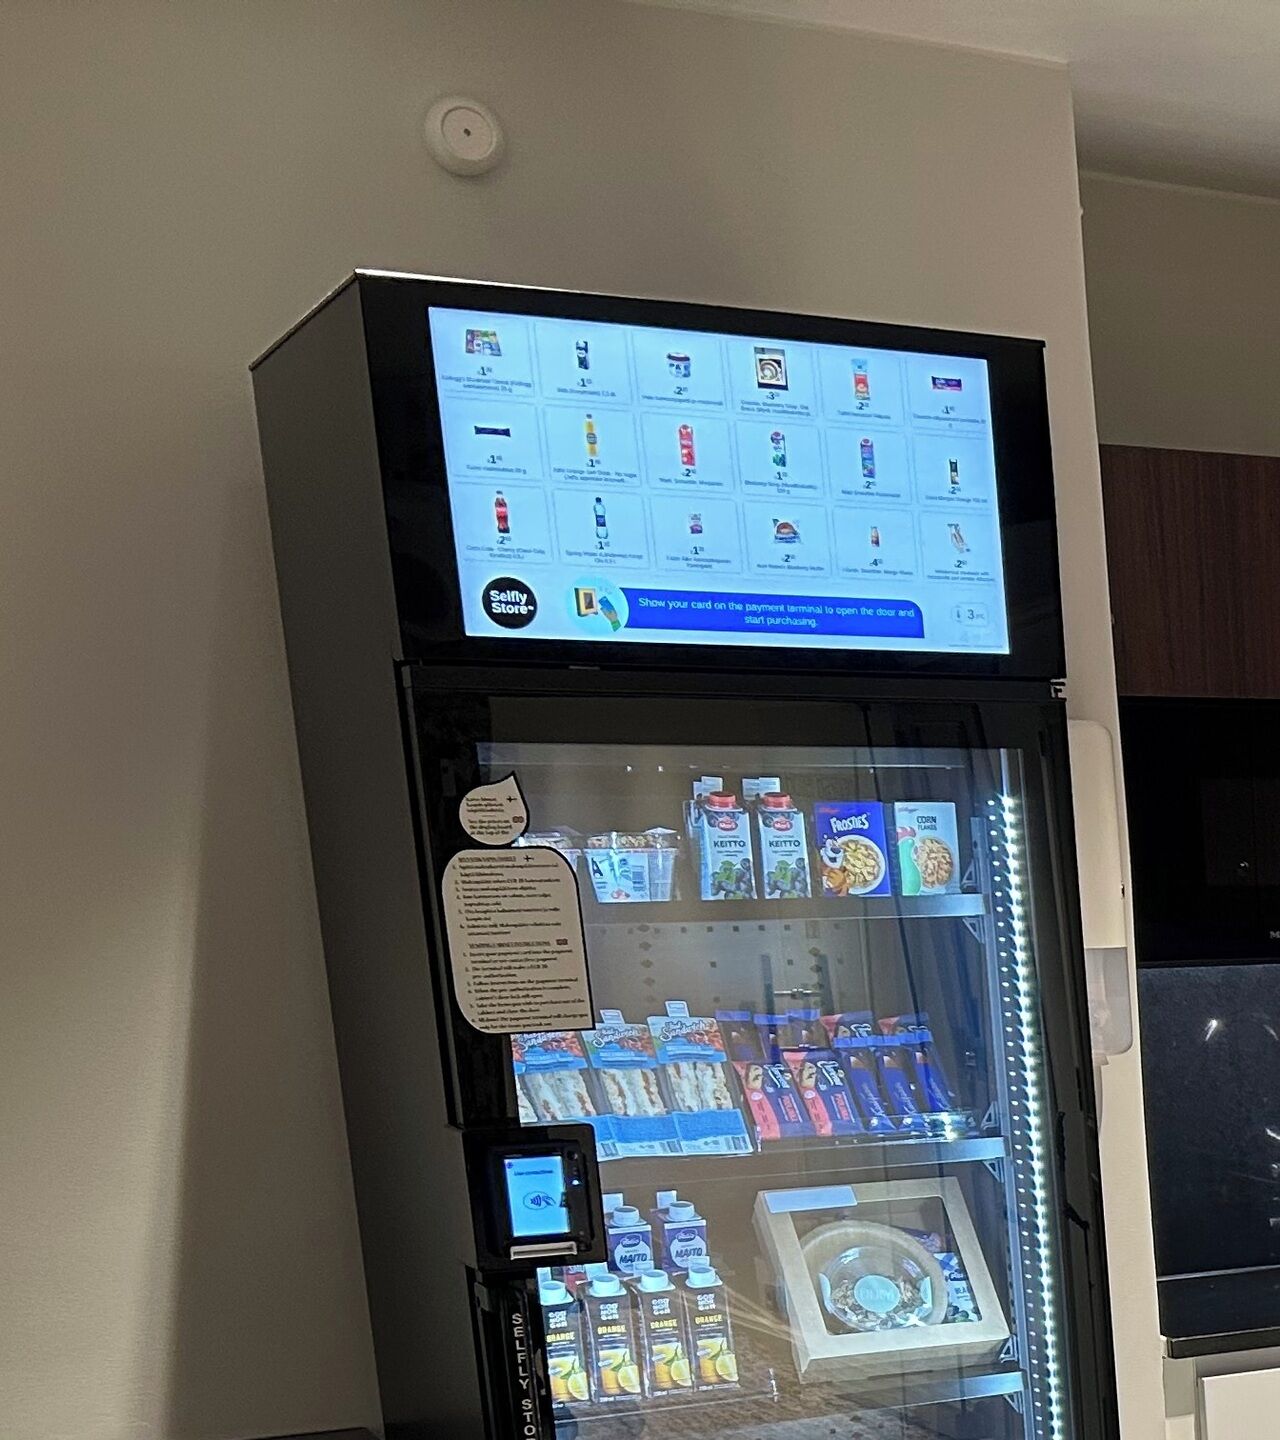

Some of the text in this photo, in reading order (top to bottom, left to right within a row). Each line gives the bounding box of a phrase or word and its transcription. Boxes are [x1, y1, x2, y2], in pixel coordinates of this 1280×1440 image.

[489, 590, 528, 605] Selfly
[638, 597, 915, 617] Show your card on the payment terminal to open the door and
[744, 614, 765, 625] start
[830, 813, 869, 833] FROSTIES
[916, 816, 937, 824] CORN
[713, 839, 747, 848] KEITTO
[768, 839, 802, 848] KEITTO
[675, 1247, 703, 1258] MAITO
[619, 1253, 648, 1265] MAITO
[650, 1319, 678, 1330] ORANGE
[694, 1314, 722, 1325] ORANGE
[597, 1324, 627, 1335] ORANGE
[547, 1331, 575, 1343] ORANGE
[511, 1313, 531, 1390] SELFLY
